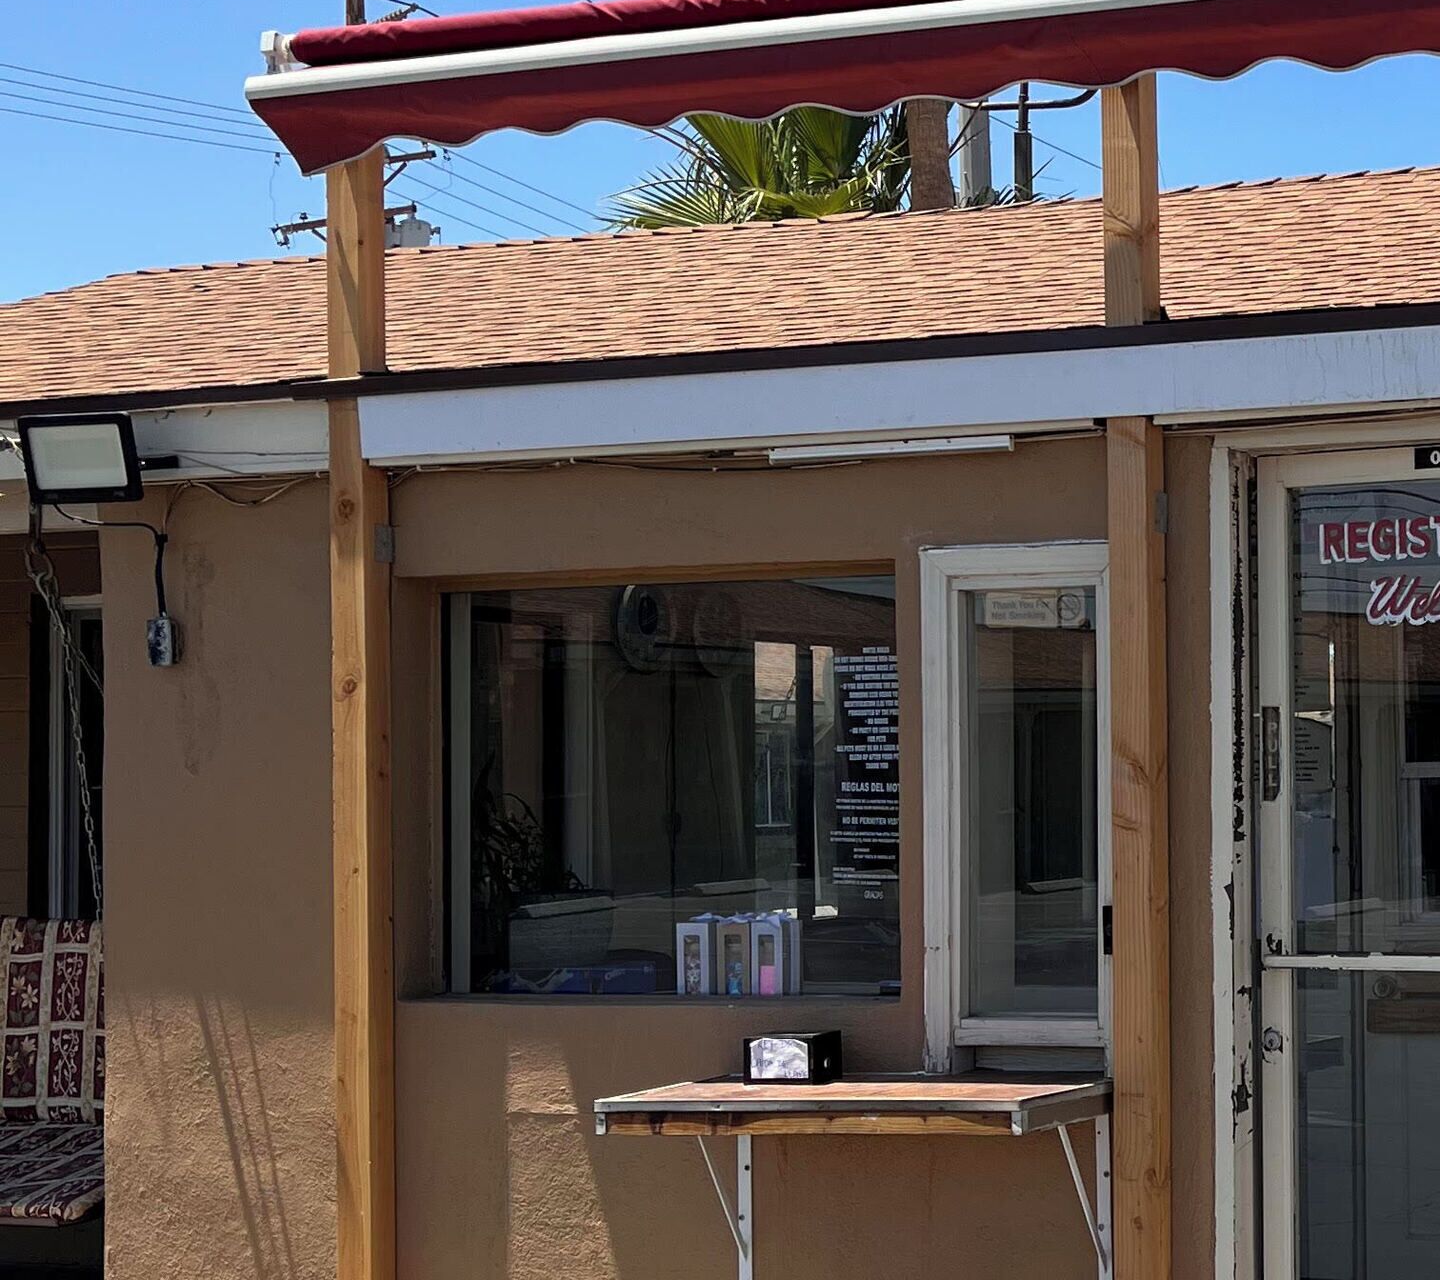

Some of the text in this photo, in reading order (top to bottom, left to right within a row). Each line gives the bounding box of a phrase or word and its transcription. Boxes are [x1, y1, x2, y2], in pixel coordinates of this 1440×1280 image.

[992, 599, 1017, 609] Thank
[1018, 599, 1034, 609] You
[1267, 722, 1277, 787] PULL
[841, 782, 870, 792] REGLAS
[871, 783, 885, 792] DEL
